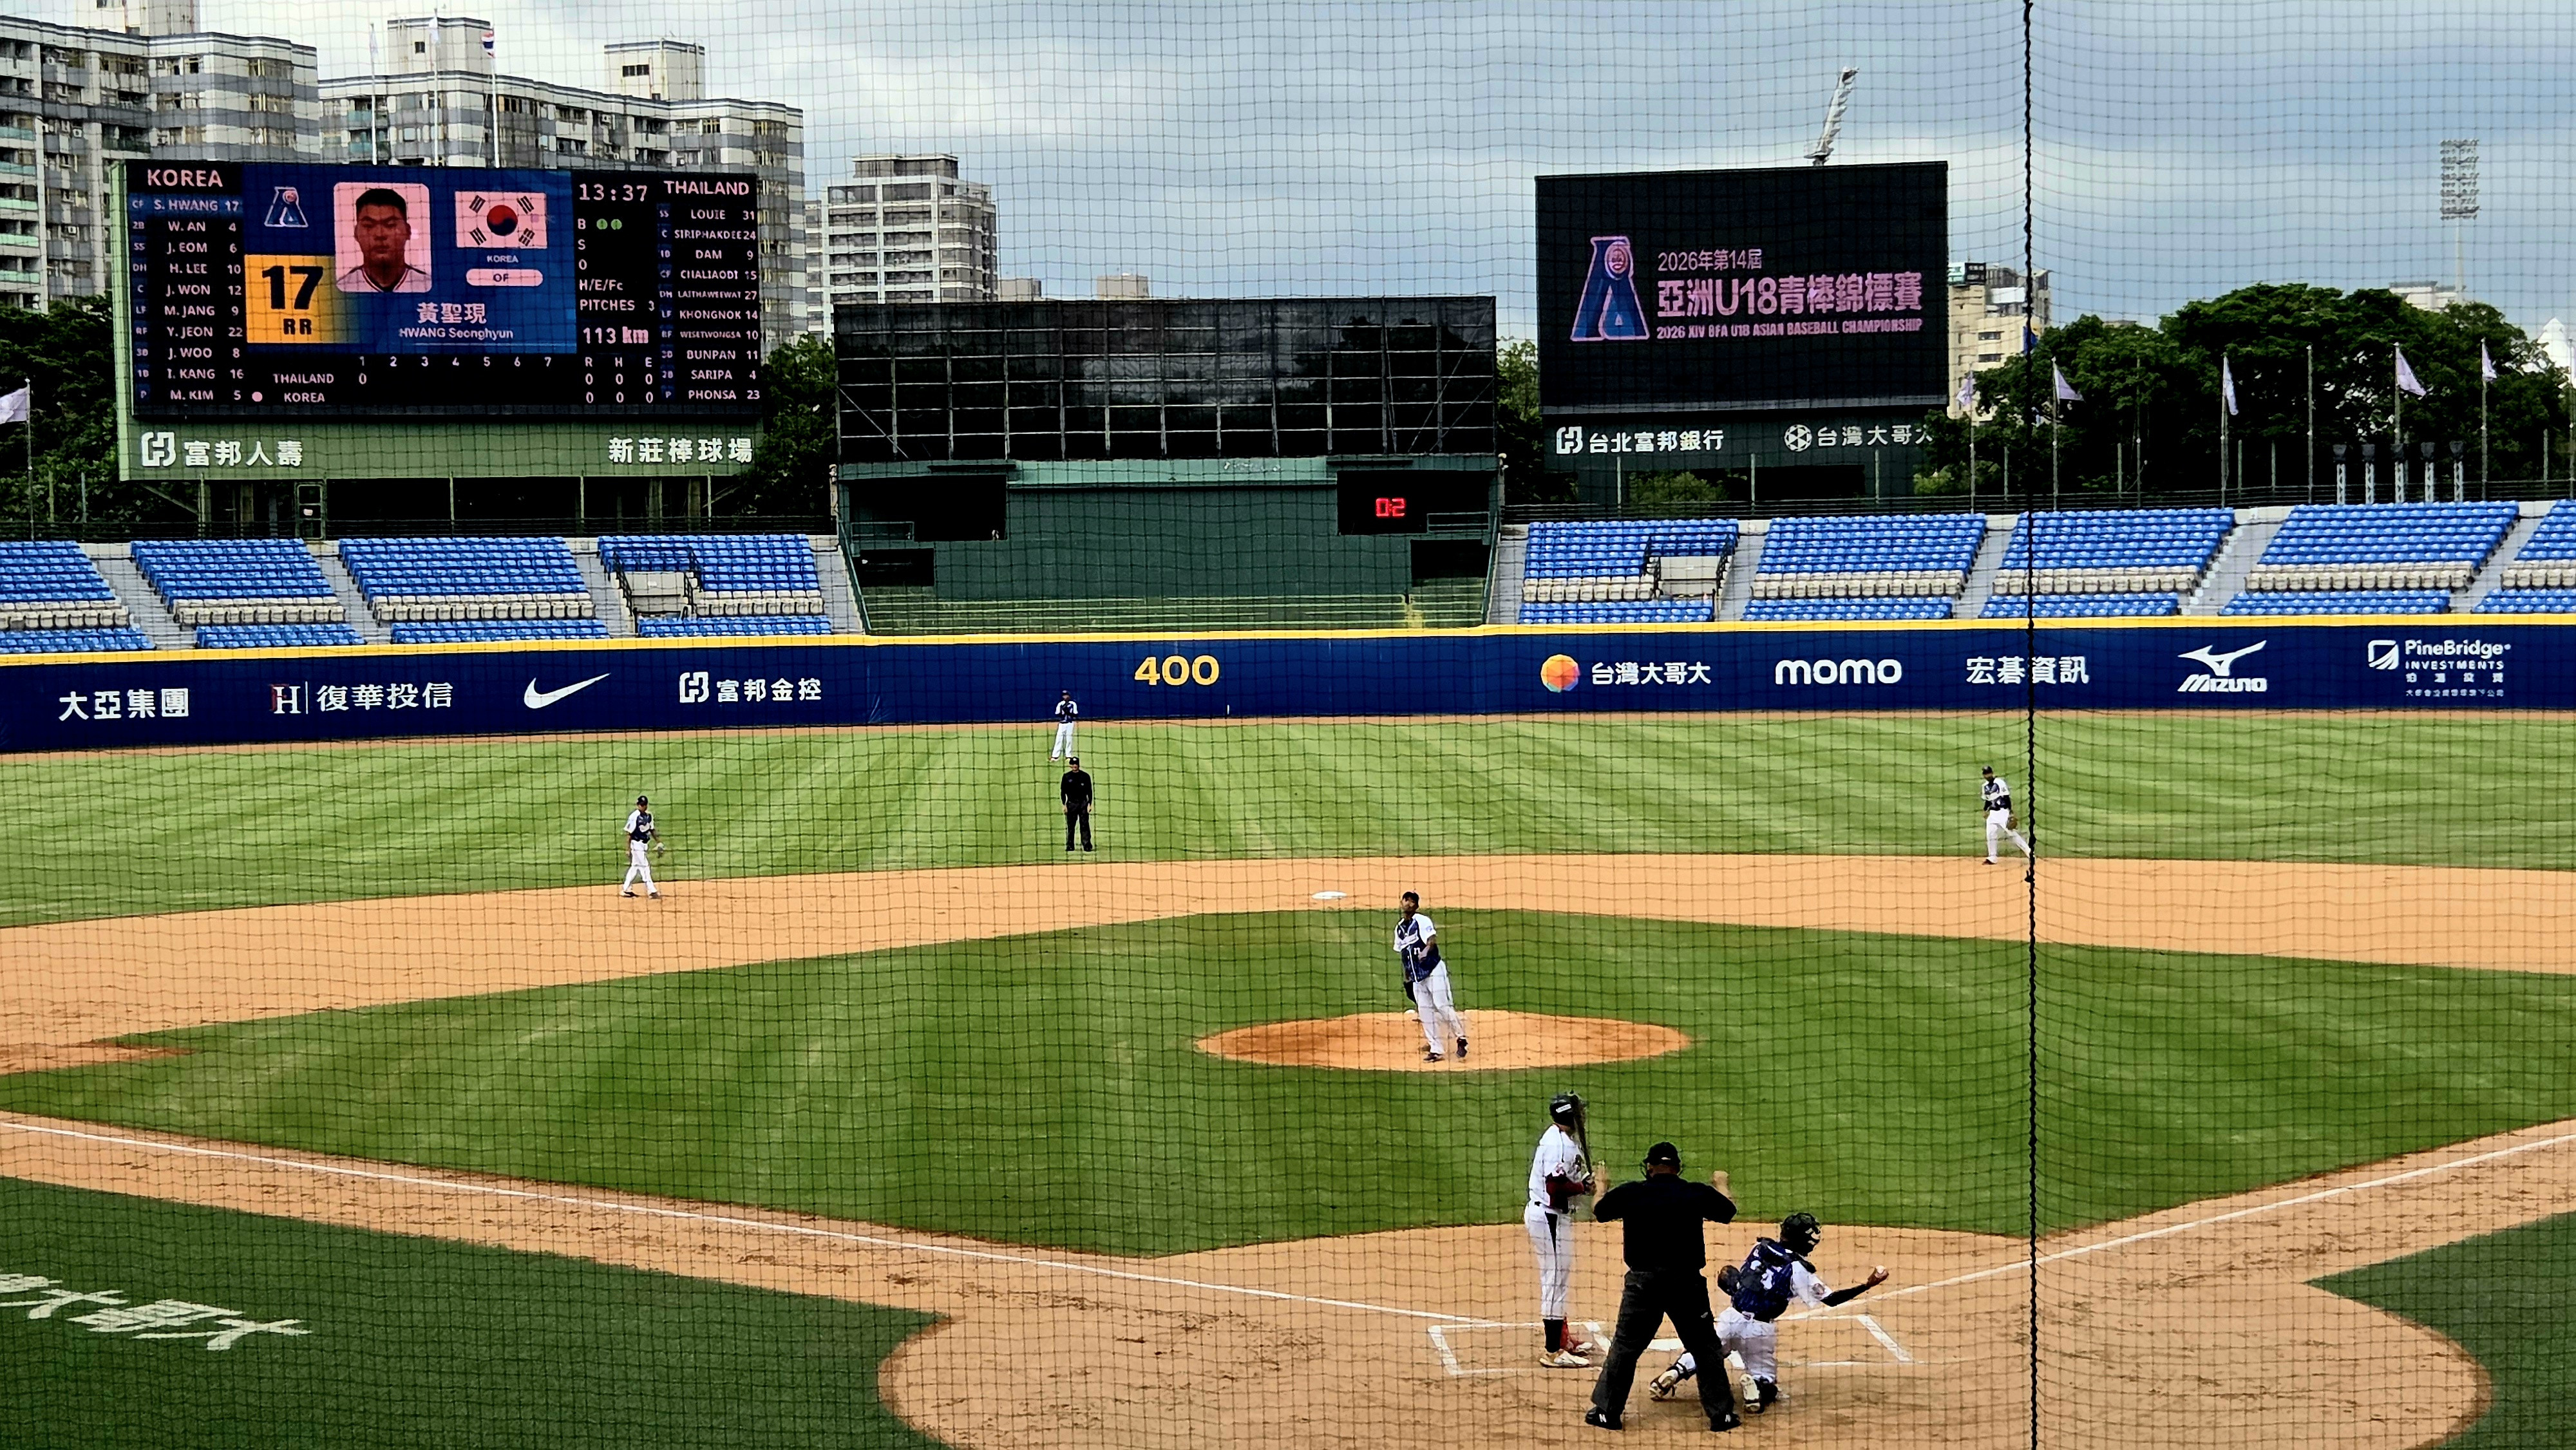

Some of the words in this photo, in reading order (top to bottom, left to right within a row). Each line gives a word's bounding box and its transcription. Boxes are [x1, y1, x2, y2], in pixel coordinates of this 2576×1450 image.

[148, 169, 223, 187] KOREA
[580, 184, 647, 202] 13:37
[664, 181, 749, 195] THAILAND
[154, 201, 166, 211] S.
[169, 201, 218, 211] HWANG
[224, 200, 239, 211] 17
[691, 210, 725, 219] LOUIE
[743, 211, 754, 220] 31
[168, 221, 184, 231] W.
[187, 221, 205, 231] AN
[229, 223, 236, 231] 4
[578, 218, 585, 229] B
[662, 229, 667, 238] C
[675, 230, 741, 240] SIRIPHAKDEE
[743, 231, 756, 240] 24
[167, 242, 175, 254] J.
[179, 243, 207, 252] EOM
[230, 243, 237, 253] 6
[578, 239, 585, 250] S
[487, 253, 518, 263] KOREA
[696, 250, 721, 259] DAM
[747, 250, 753, 260] 9
[1658, 249, 1762, 271] 2026年第14屆
[170, 263, 182, 273] H.
[187, 264, 207, 274] LEE
[227, 265, 241, 274] 10
[492, 273, 509, 282] OF
[745, 271, 757, 279] 15
[166, 285, 175, 297] J.
[178, 285, 210, 294] WON
[229, 285, 242, 295] 12
[262, 266, 323, 310] 17
[1658, 271, 1922, 317] 亞洲U18青棒錦標賽
[745, 291, 757, 299] 27
[580, 299, 634, 310] PITCHES
[649, 301, 654, 311] 3
[165, 306, 179, 315] M.
[182, 306, 214, 317] JANG
[232, 306, 238, 315] 9
[417, 302, 487, 324] 黃聖現
[680, 310, 741, 319] KHONGNOK
[746, 310, 757, 319] 14
[167, 326, 178, 336] Y.
[181, 326, 213, 339] JEON
[229, 327, 242, 337] 22
[283, 319, 312, 335] RR
[1657, 326, 1685, 339] 2026
[1689, 325, 1705, 338] XIV
[1709, 325, 1728, 337] BFA
[1731, 325, 1750, 337] U18
[1753, 323, 1784, 336] ASIAN
[1787, 321, 1839, 335] BASEBALL
[1842, 319, 1922, 333] CHAMPIONSHIP
[399, 328, 445, 337] HWANG
[449, 327, 515, 341] Seonghyun
[583, 328, 616, 344] 113
[622, 326, 649, 343] km
[746, 330, 758, 339] 10
[168, 348, 176, 360] J.
[180, 348, 212, 358] WOO
[233, 348, 240, 358] 8
[687, 350, 735, 359] BUNPAN
[746, 350, 757, 359] 11
[359, 356, 364, 366] 1
[390, 356, 397, 366] 2
[422, 357, 428, 366] 3
[452, 357, 459, 366] 4
[484, 357, 490, 366] 5
[515, 357, 520, 366] 6
[545, 357, 551, 366] 7
[585, 357, 592, 366] R
[615, 357, 622, 367] H
[645, 357, 652, 367] E
[167, 368, 175, 379] I.
[180, 369, 214, 379] KANG
[230, 369, 243, 379] 16
[273, 373, 334, 383] THAILAND
[359, 373, 366, 384] 0
[585, 373, 593, 384] 0
[616, 373, 623, 384] 0
[645, 373, 652, 384] 0
[692, 370, 732, 379] SARIPA
[750, 370, 756, 379] 4
[171, 390, 185, 400] M.
[189, 390, 213, 400] KIM
[234, 390, 241, 400] 5
[284, 393, 325, 402] KOREA
[586, 392, 593, 403] 0
[616, 392, 623, 402] 0
[646, 391, 653, 403] 0
[688, 390, 736, 399] PHONSA
[747, 390, 760, 399] 23
[1589, 429, 1725, 454] 台北富邦銀行
[184, 440, 303, 467] 富邦人壽
[609, 438, 753, 463] 新莊棒球場
[1376, 498, 1406, 517] 02
[2405, 639, 2504, 659] PineBridge
[1134, 655, 1220, 686] 400
[1776, 659, 1902, 684] momo
[1966, 656, 2089, 684] 宏碁資訊
[2405, 661, 2504, 670] INVESTMENTS
[1591, 661, 1711, 685] 台灣大哥大
[716, 678, 822, 702] 富邦金控
[316, 683, 453, 712] 復華投信
[58, 688, 189, 721] 大亞集團
